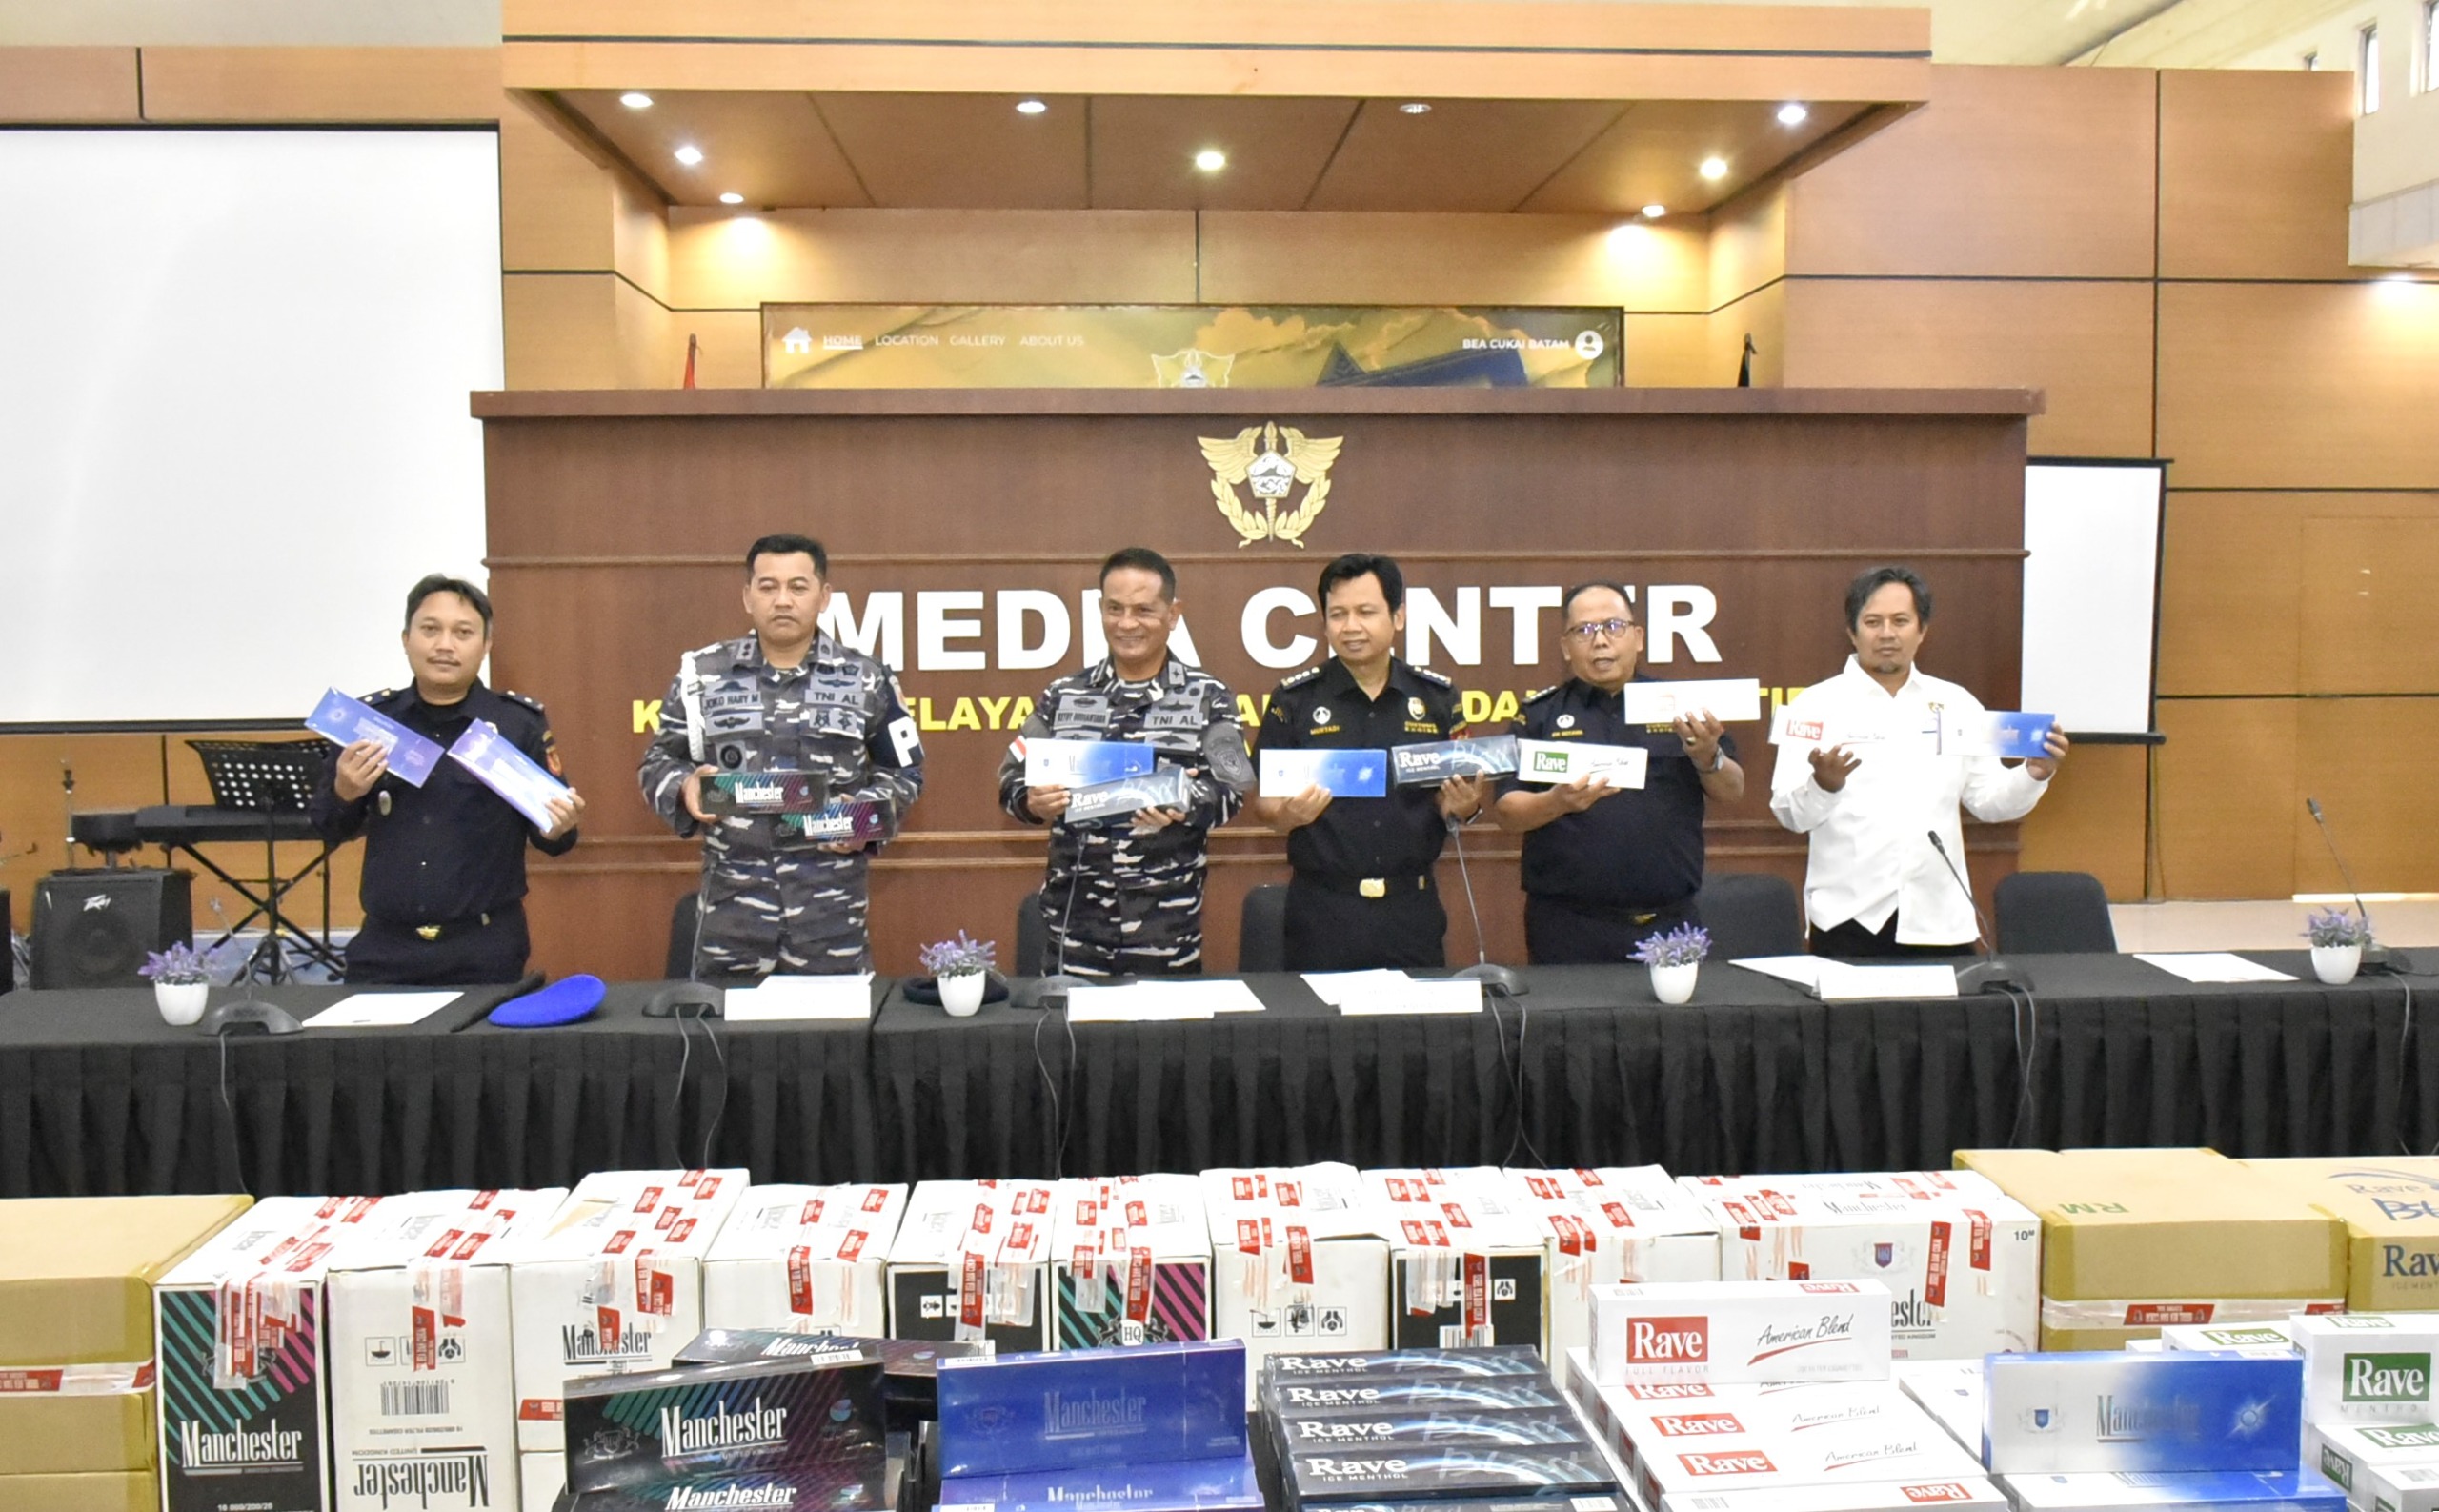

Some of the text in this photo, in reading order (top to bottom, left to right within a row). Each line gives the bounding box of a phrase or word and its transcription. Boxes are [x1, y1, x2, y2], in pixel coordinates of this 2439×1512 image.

[823, 335, 1084, 349] HOME LOCATION GALLERY ABOUT US
[1462, 339, 1570, 349] BEA CUKAI BATAM
[1241, 584, 1723, 668] CNTR
[814, 692, 859, 704] TNI AL
[1153, 716, 1199, 725] TNI AL
[1399, 752, 1441, 768] Rave
[1536, 753, 1566, 771] Rave
[735, 781, 784, 804] Manchester
[1071, 791, 1109, 808] Rave
[803, 812, 854, 837] Manchester
[2382, 1244, 2439, 1277] Rav
[1124, 1325, 1142, 1342] HQ
[1757, 1314, 1855, 1346] American Blend
[1633, 1321, 1703, 1360] Rave
[1280, 1356, 1368, 1370] Rave
[1625, 1365, 1709, 1375] FULL FLAVOR
[2349, 1359, 2424, 1396] Rave
[1287, 1387, 1381, 1402] Rave
[1044, 1387, 1147, 1433] Manchester
[2341, 1404, 2429, 1413] MENTHOL
[1660, 1415, 1738, 1435] Rave
[1792, 1412, 1844, 1423] American
[661, 1397, 788, 1458] Manchester
[1297, 1421, 1395, 1438] Rave
[180, 1419, 303, 1468] Manchester
[1686, 1453, 1768, 1475] Rave
[1825, 1451, 1880, 1462] American
[1306, 1458, 1409, 1476] Rave
[353, 1455, 490, 1511] Manchester
[1348, 1472, 1408, 1481] MENTHOL
[664, 1482, 797, 1510] Manchester
[1905, 1483, 1967, 1500] Rave
